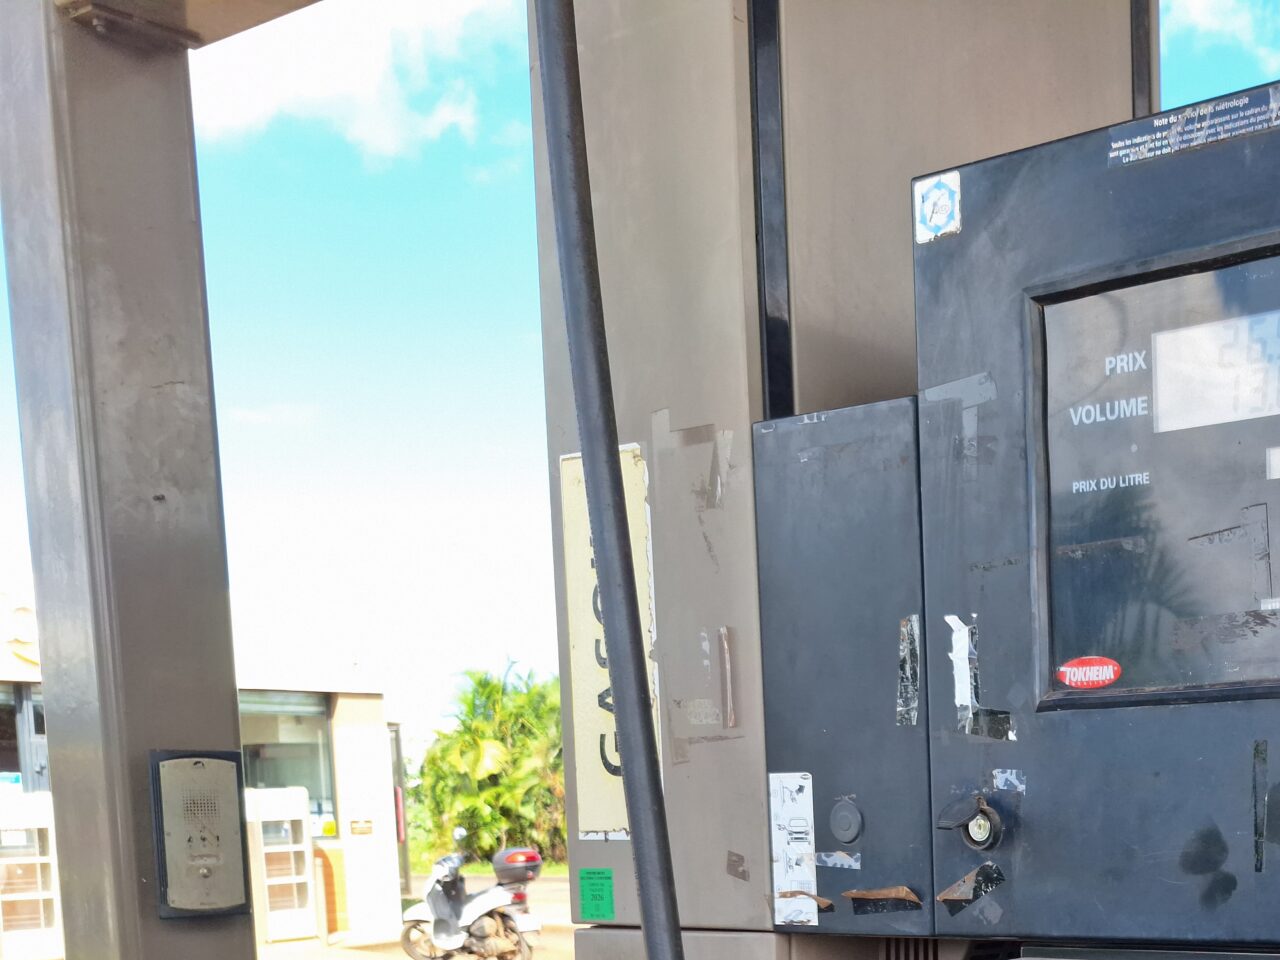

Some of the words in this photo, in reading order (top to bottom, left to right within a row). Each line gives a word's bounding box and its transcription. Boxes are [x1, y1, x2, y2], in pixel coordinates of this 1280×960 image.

[1154, 118, 1168, 127] Note
[1169, 115, 1178, 123] du
[1104, 351, 1147, 376] PRIX
[1069, 396, 1148, 426] VOLUME
[1072, 480, 1097, 494] PRIX
[1100, 477, 1116, 490] DU
[1120, 472, 1150, 488] LITRE
[1058, 665, 1115, 685] TOKHEIM
